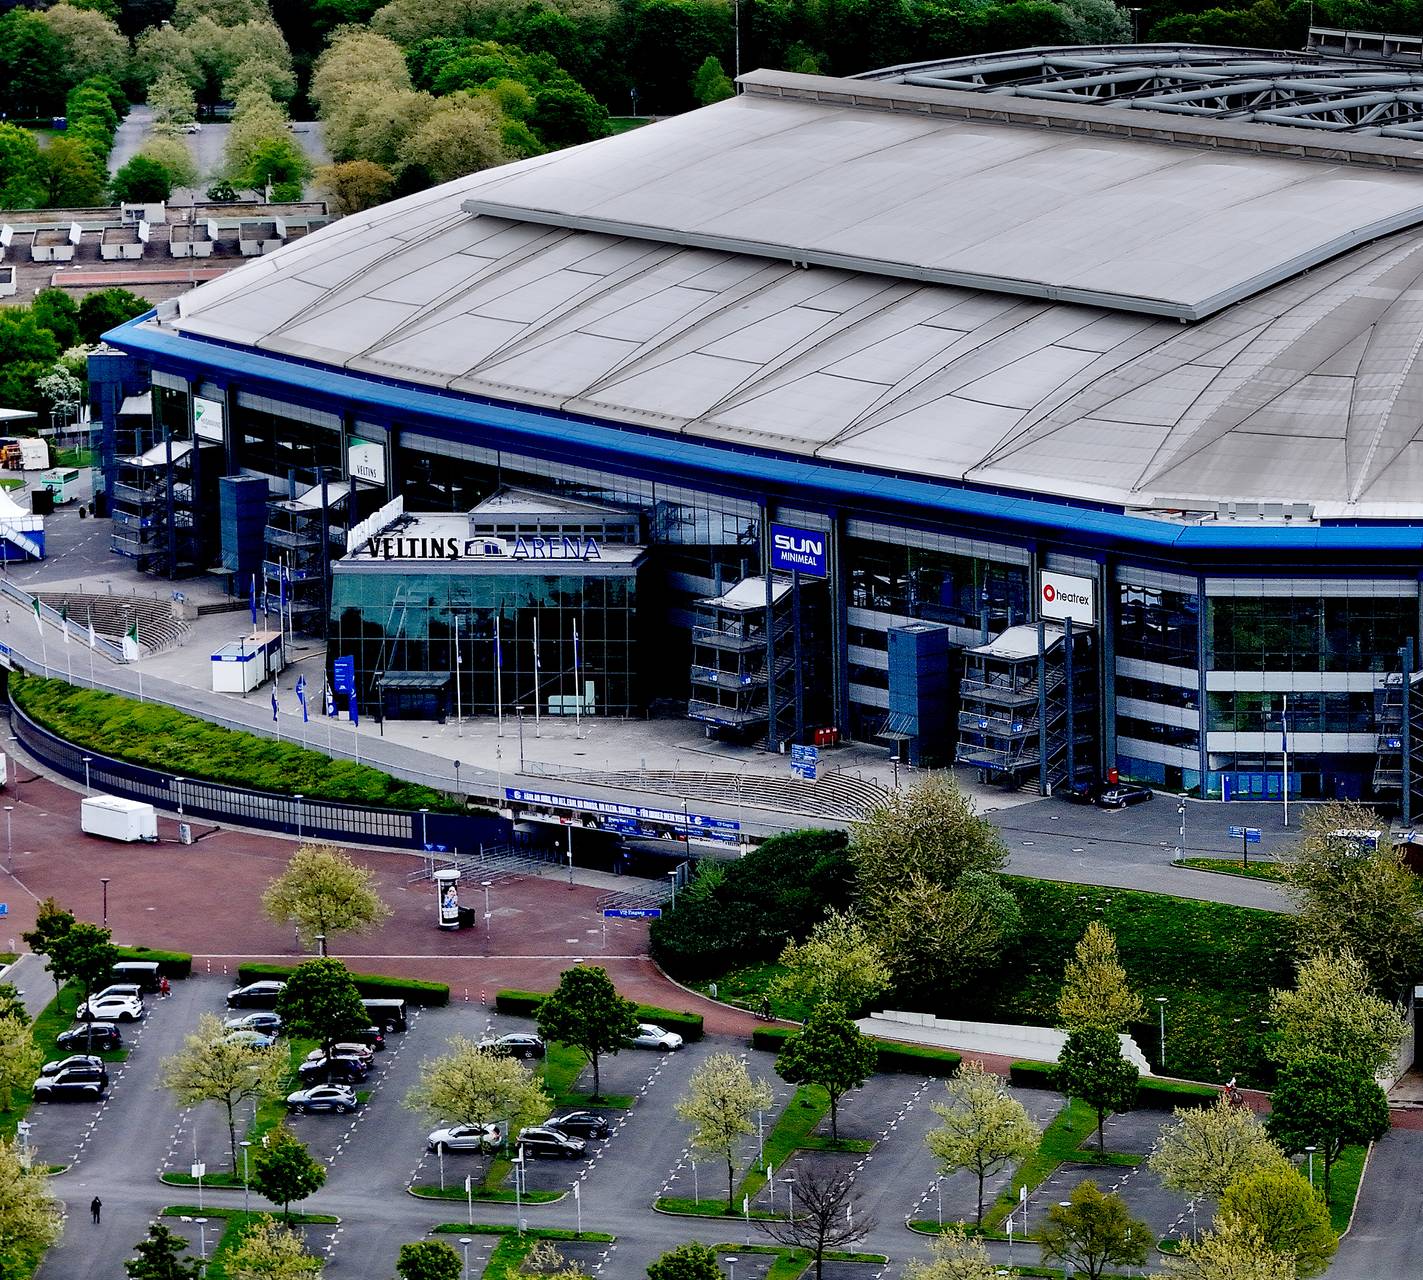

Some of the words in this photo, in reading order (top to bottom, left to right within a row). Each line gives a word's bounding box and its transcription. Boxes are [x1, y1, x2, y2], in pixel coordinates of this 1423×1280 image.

[356, 465, 377, 478] VELTINS
[367, 537, 463, 559] VELTINS
[512, 537, 602, 559] ARENA
[774, 534, 822, 555] SUN
[780, 550, 817, 566] MINIMEAL
[1056, 589, 1089, 605] heatrex
